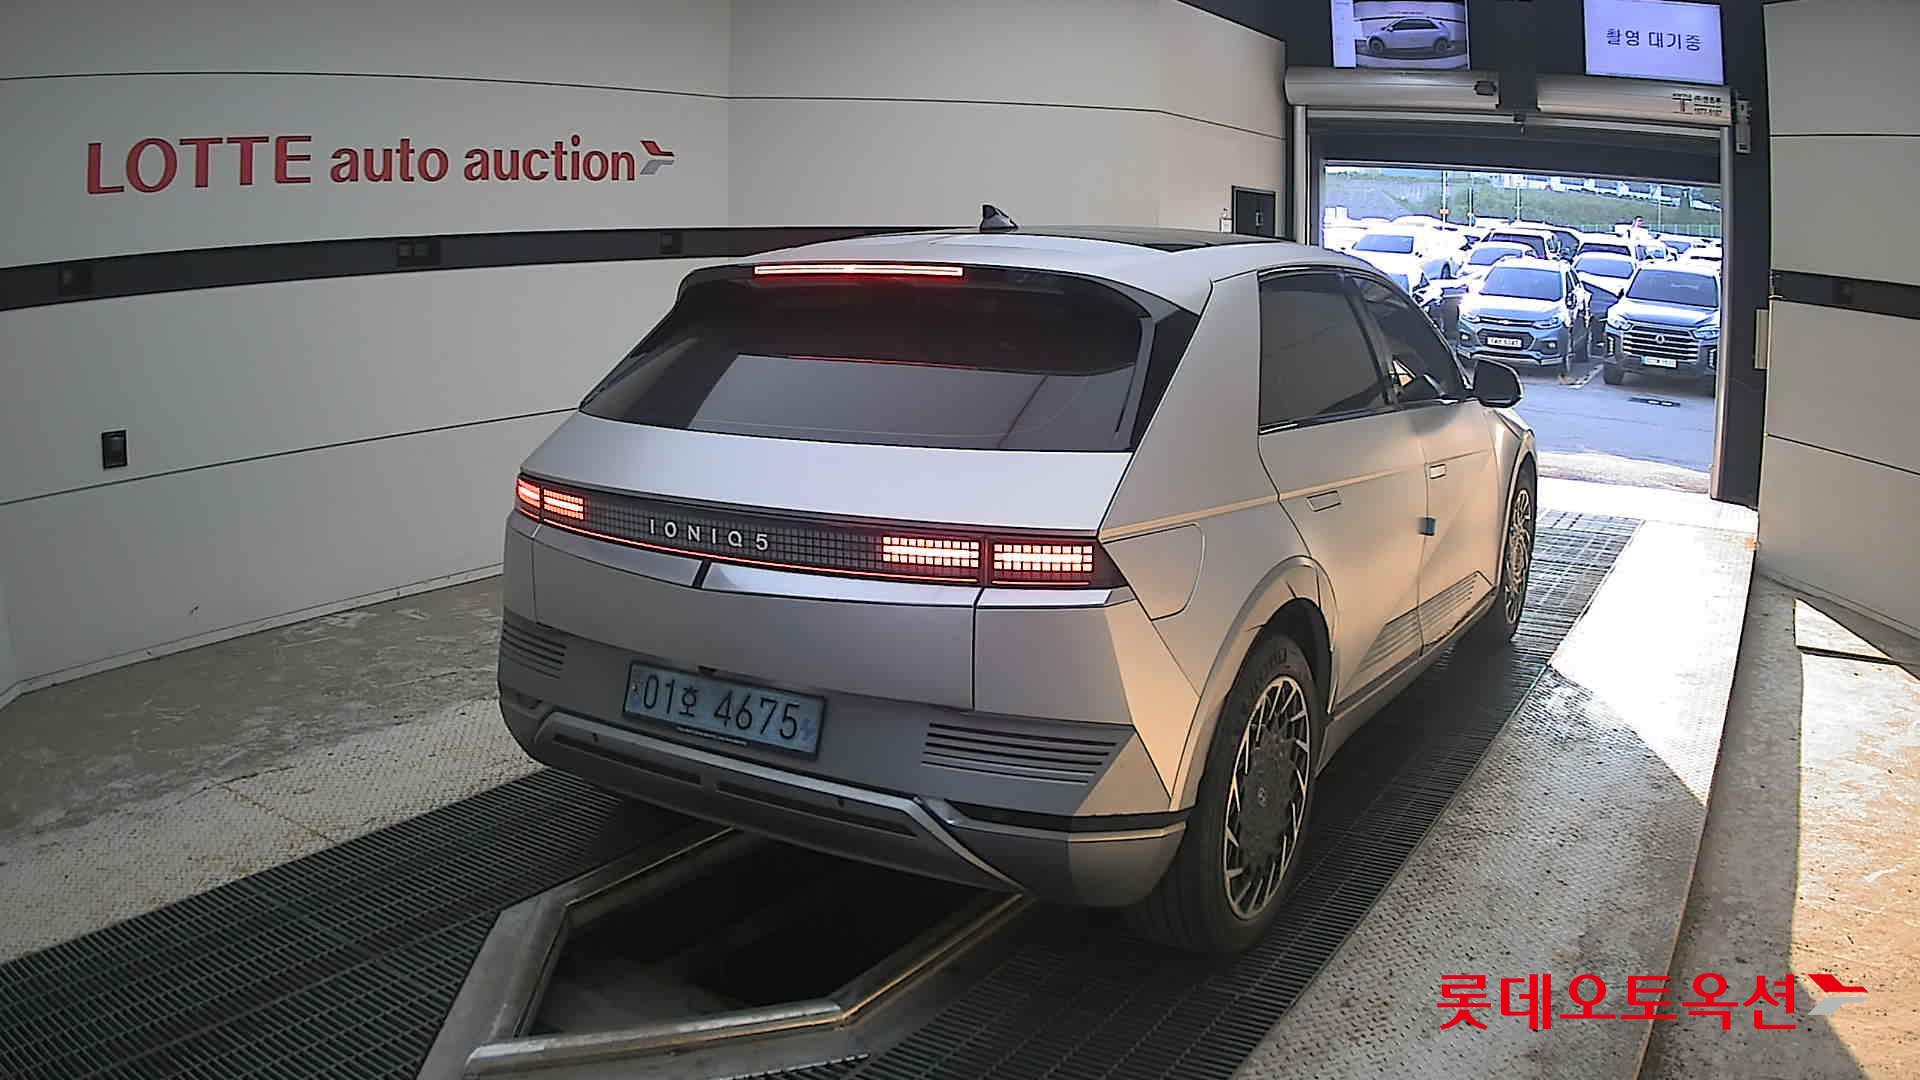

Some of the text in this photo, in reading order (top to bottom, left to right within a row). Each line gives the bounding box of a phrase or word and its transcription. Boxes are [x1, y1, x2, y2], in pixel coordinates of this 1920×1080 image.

[1606, 28, 1701, 52] 촬영 대기중
[86, 135, 636, 195] LOTTE auto auction
[649, 518, 769, 551] IONIQ 5
[643, 674, 698, 717] 01호
[714, 689, 801, 740] 4675
